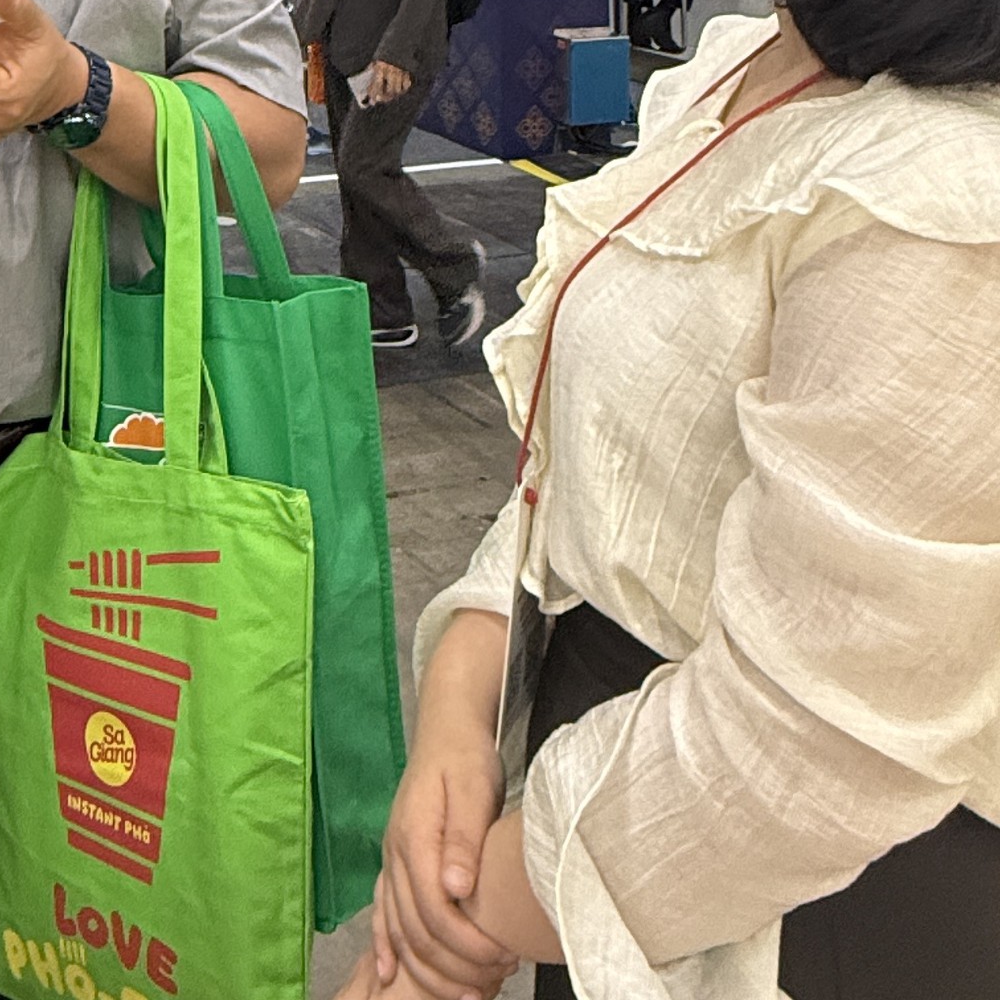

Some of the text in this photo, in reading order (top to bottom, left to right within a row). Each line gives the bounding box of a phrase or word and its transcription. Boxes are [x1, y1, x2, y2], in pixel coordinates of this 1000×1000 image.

[103, 724, 125, 746] Sa
[90, 741, 135, 771] Giang
[67, 794, 121, 832] INSTANT
[53, 882, 179, 996] LOVE
